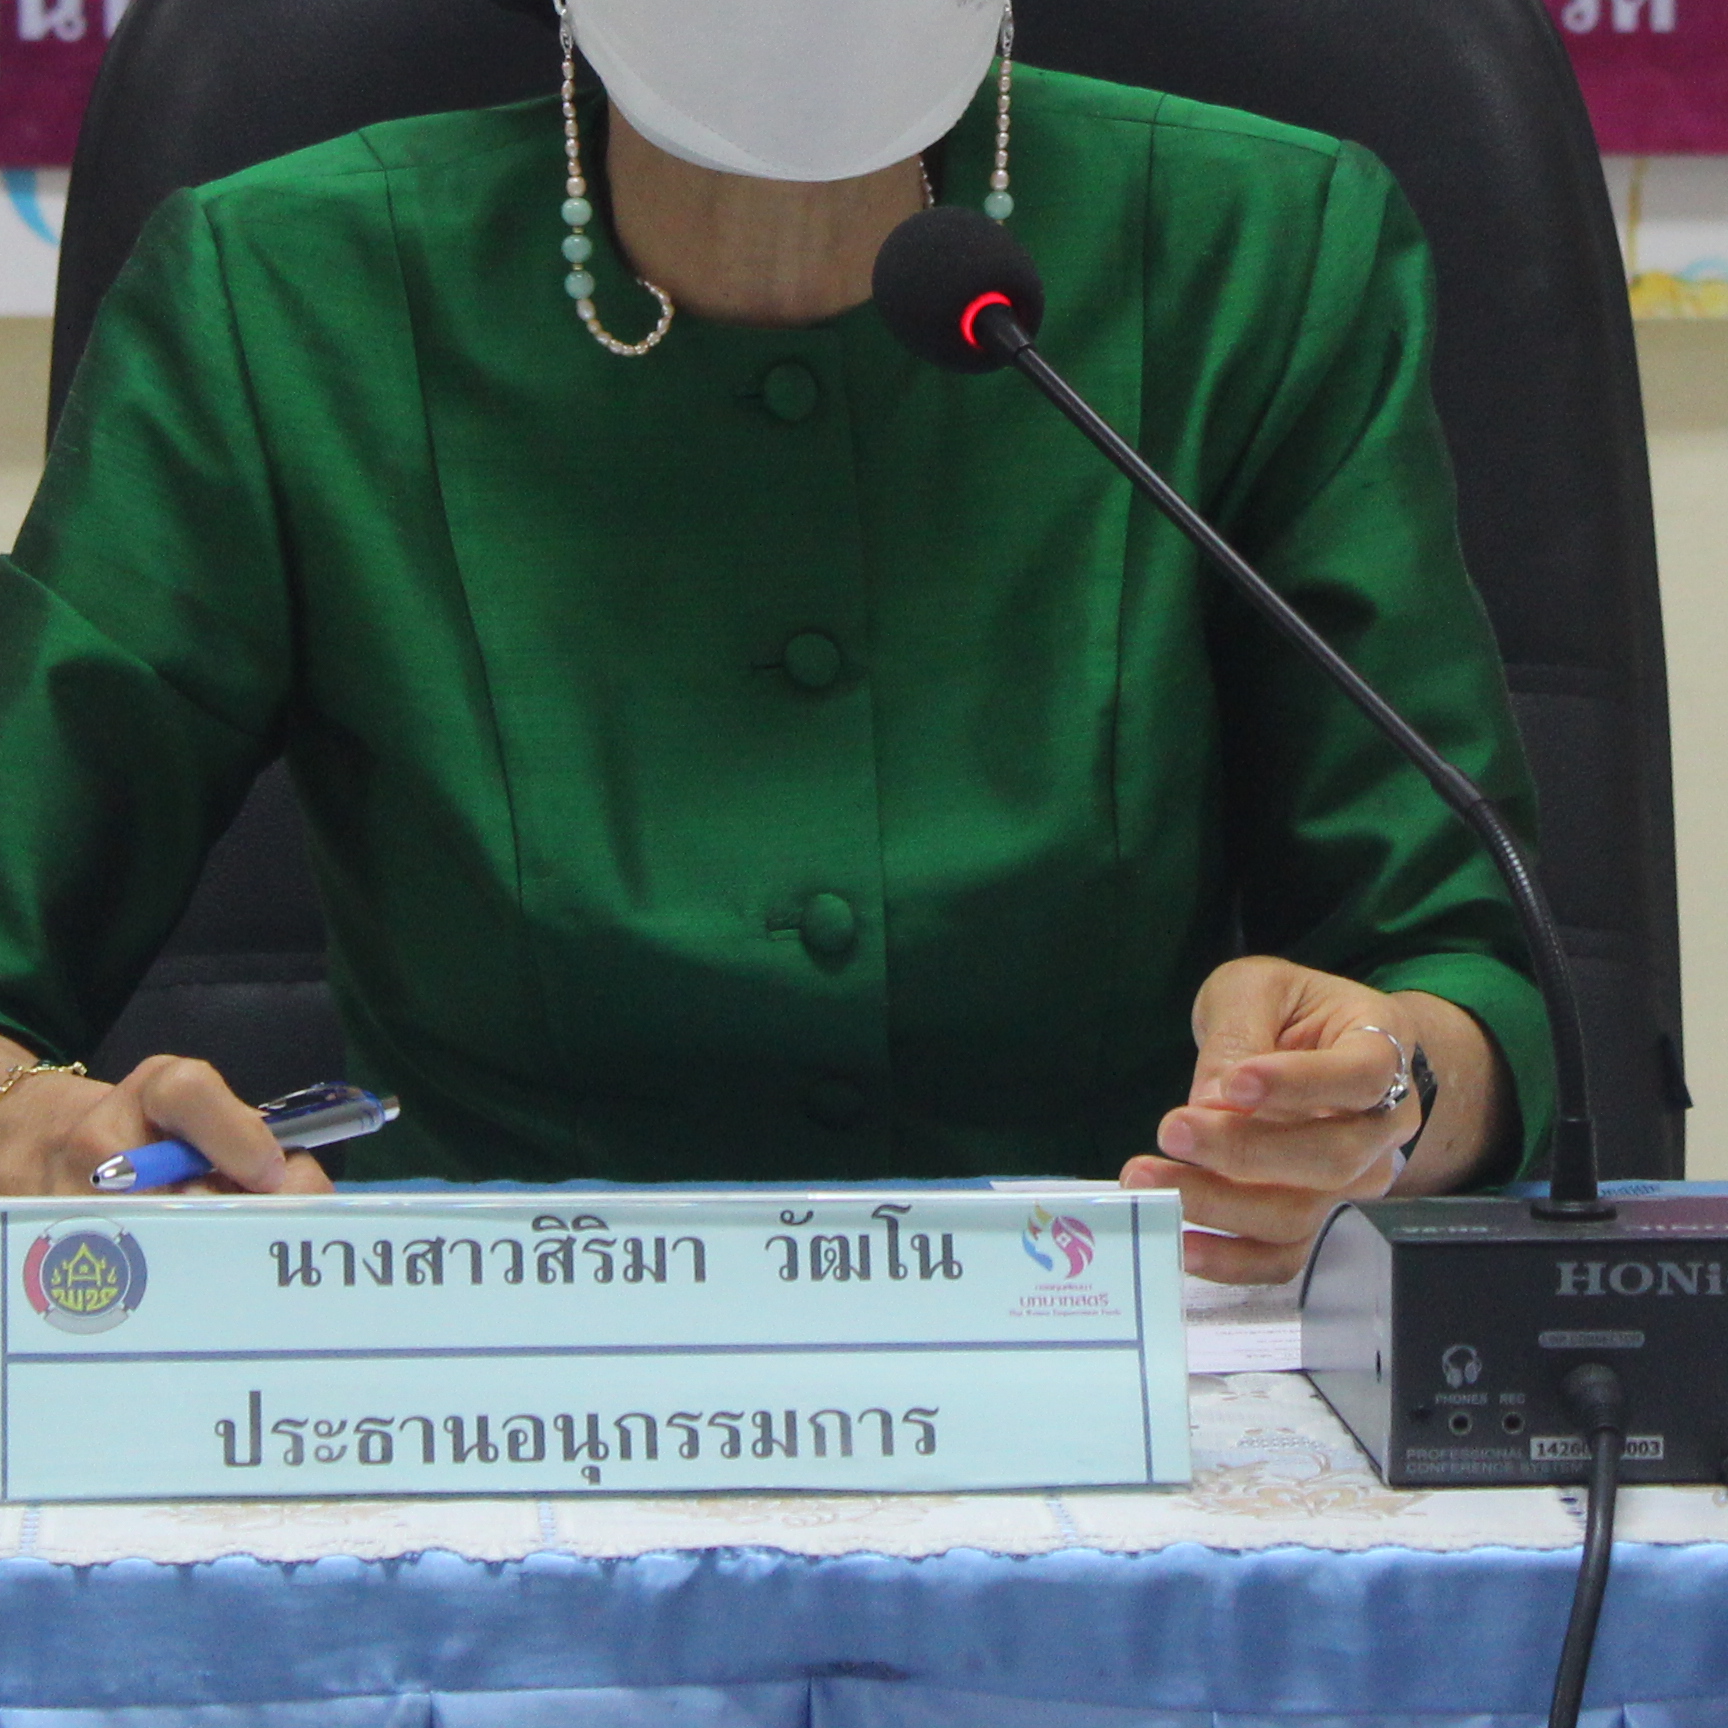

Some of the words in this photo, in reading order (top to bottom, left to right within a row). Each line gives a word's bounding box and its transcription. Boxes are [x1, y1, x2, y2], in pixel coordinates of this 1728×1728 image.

[268, 1211, 707, 1287] นางสาวสิริมา
[764, 1203, 964, 1282] วัฒโน
[213, 1389, 940, 1484] ประธานอนุกรรมการ
